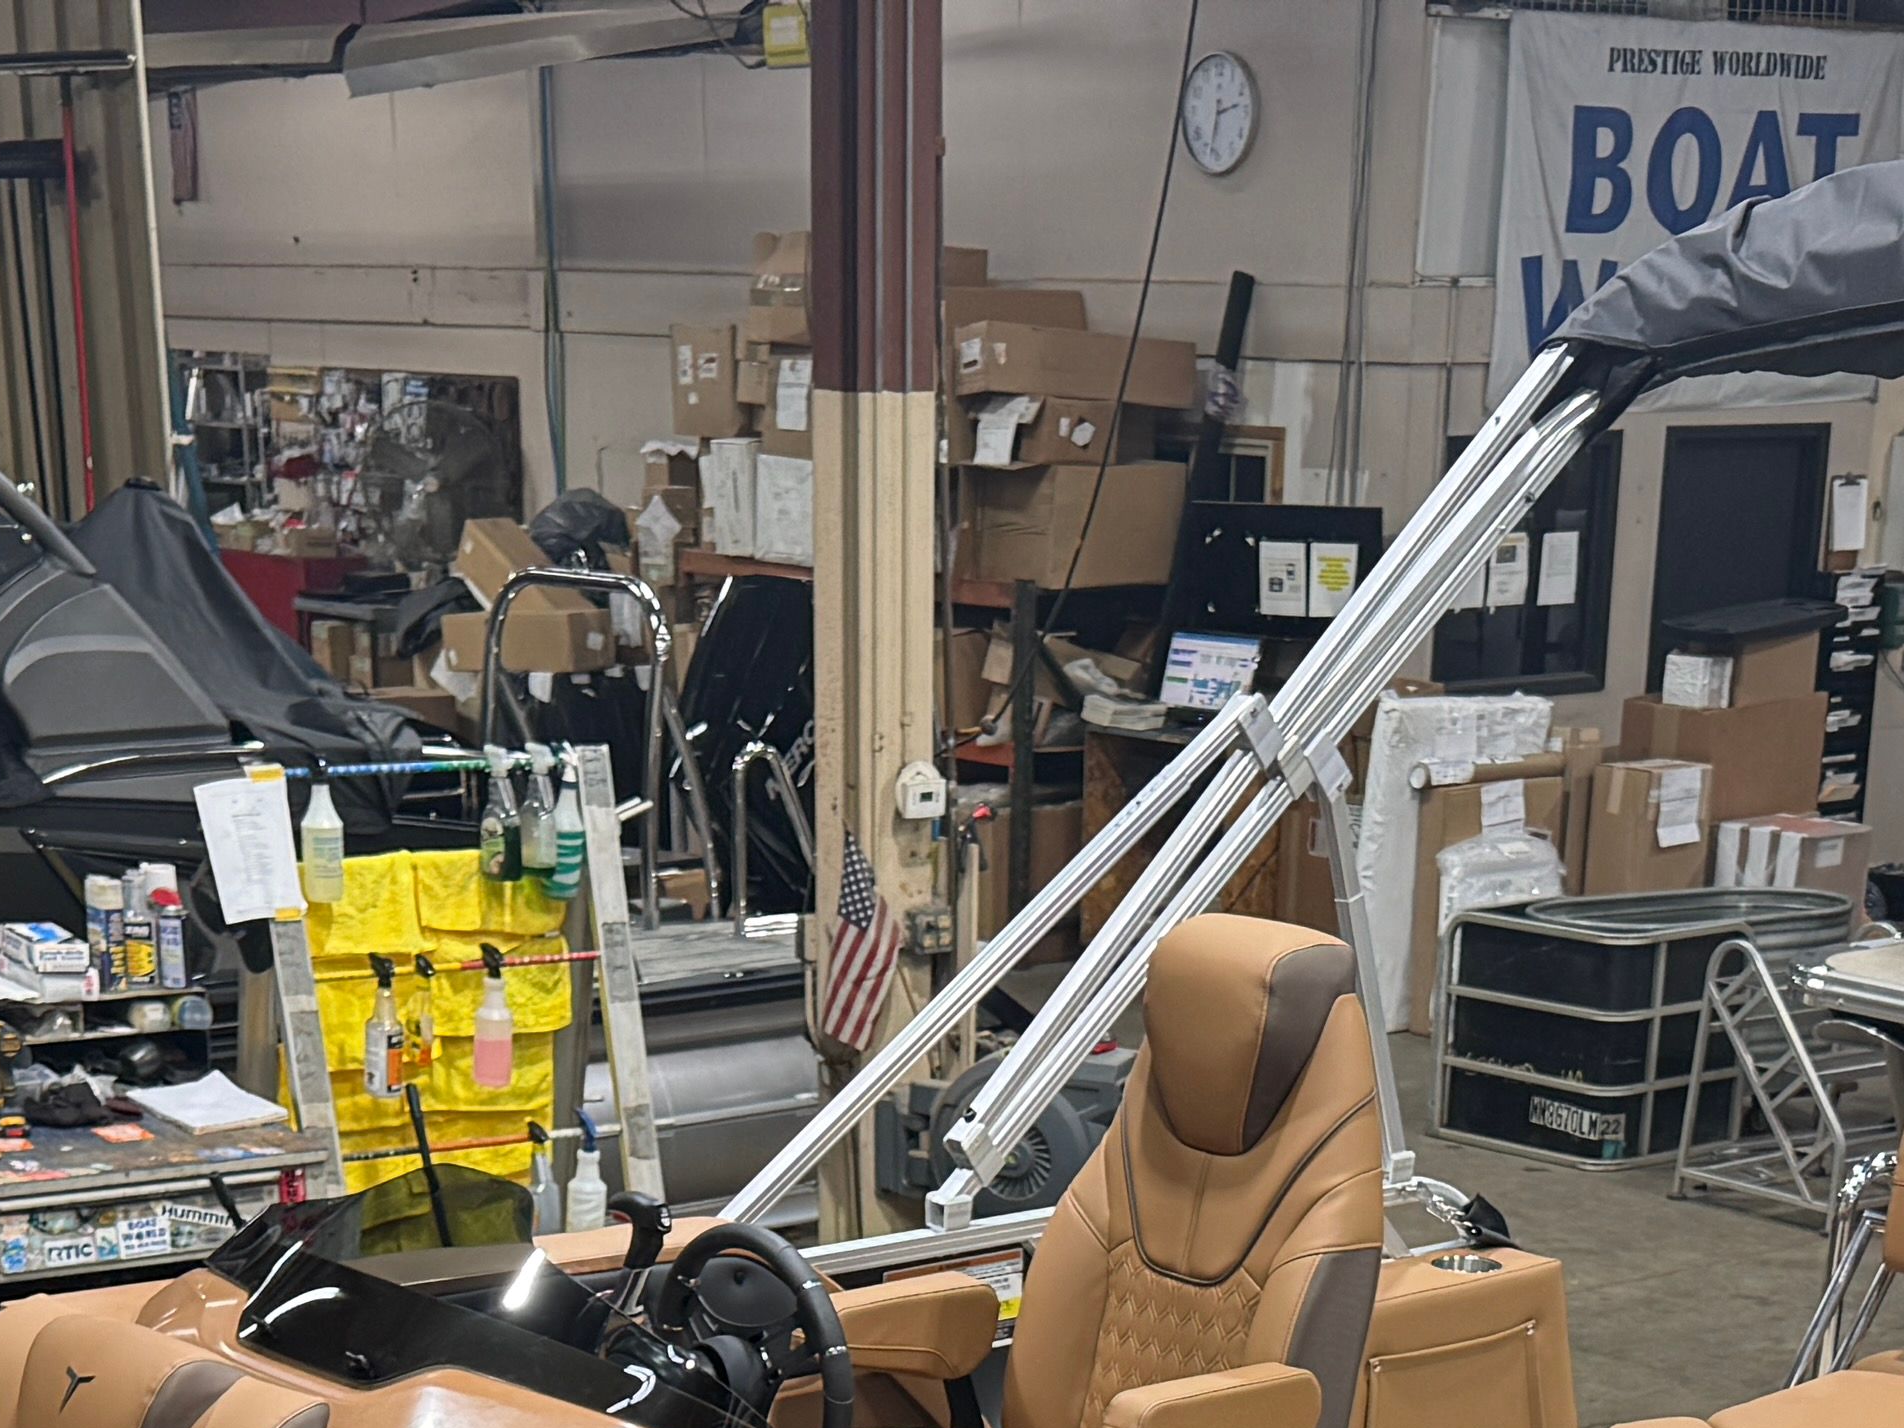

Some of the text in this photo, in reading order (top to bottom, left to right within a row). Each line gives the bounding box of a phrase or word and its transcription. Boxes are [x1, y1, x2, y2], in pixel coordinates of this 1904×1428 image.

[1607, 47, 1827, 80] PRESTIGE WORLDWIDE
[1565, 105, 1860, 235] BOAT
[48, 1243, 93, 1262] RTIC
